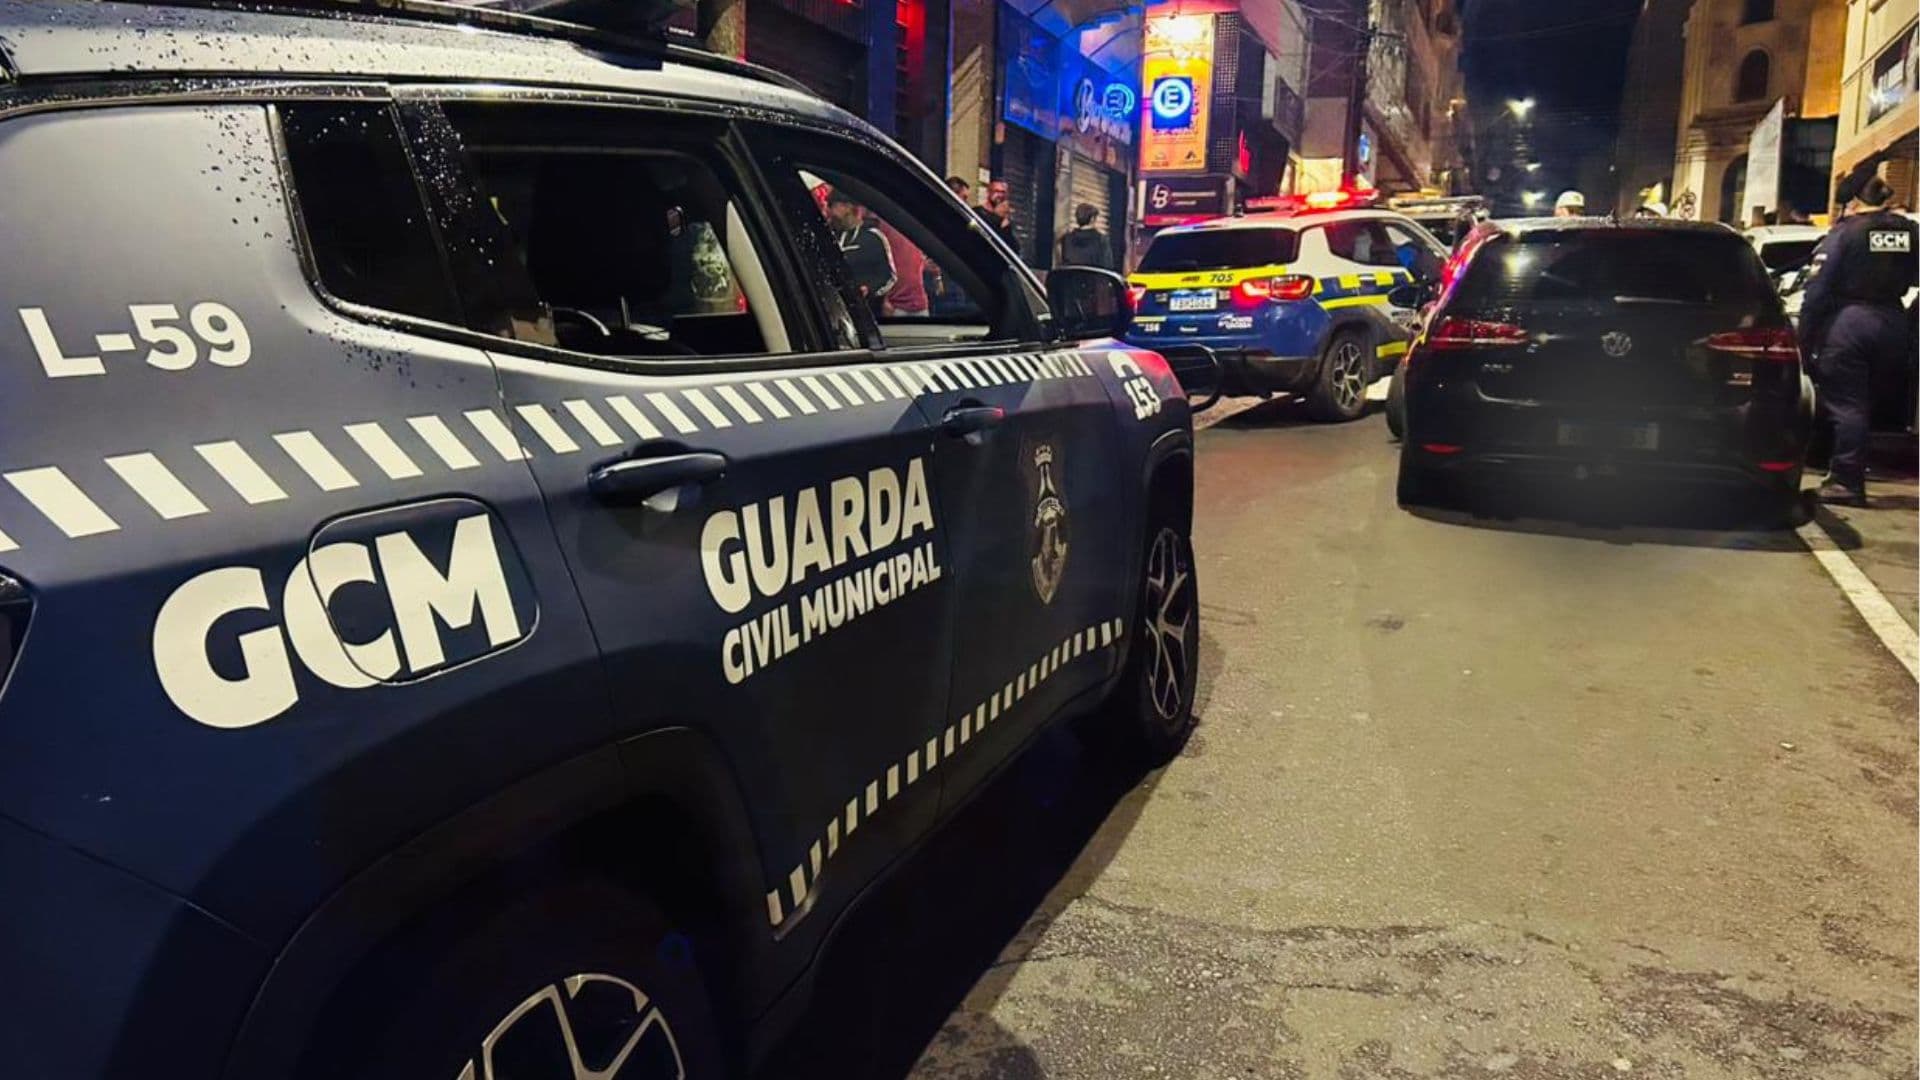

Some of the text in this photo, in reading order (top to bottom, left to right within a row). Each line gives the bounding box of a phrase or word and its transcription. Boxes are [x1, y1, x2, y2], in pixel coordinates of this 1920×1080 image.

[1164, 85, 1182, 109] E
[1870, 233, 1909, 249] GCM
[1210, 273, 1234, 283] 705
[18, 302, 252, 378] L-59
[1124, 376, 1161, 420] 153
[701, 457, 934, 613] GUARDA
[153, 513, 522, 729] GCM
[722, 541, 941, 684] CIVIL MUNICIPAL
